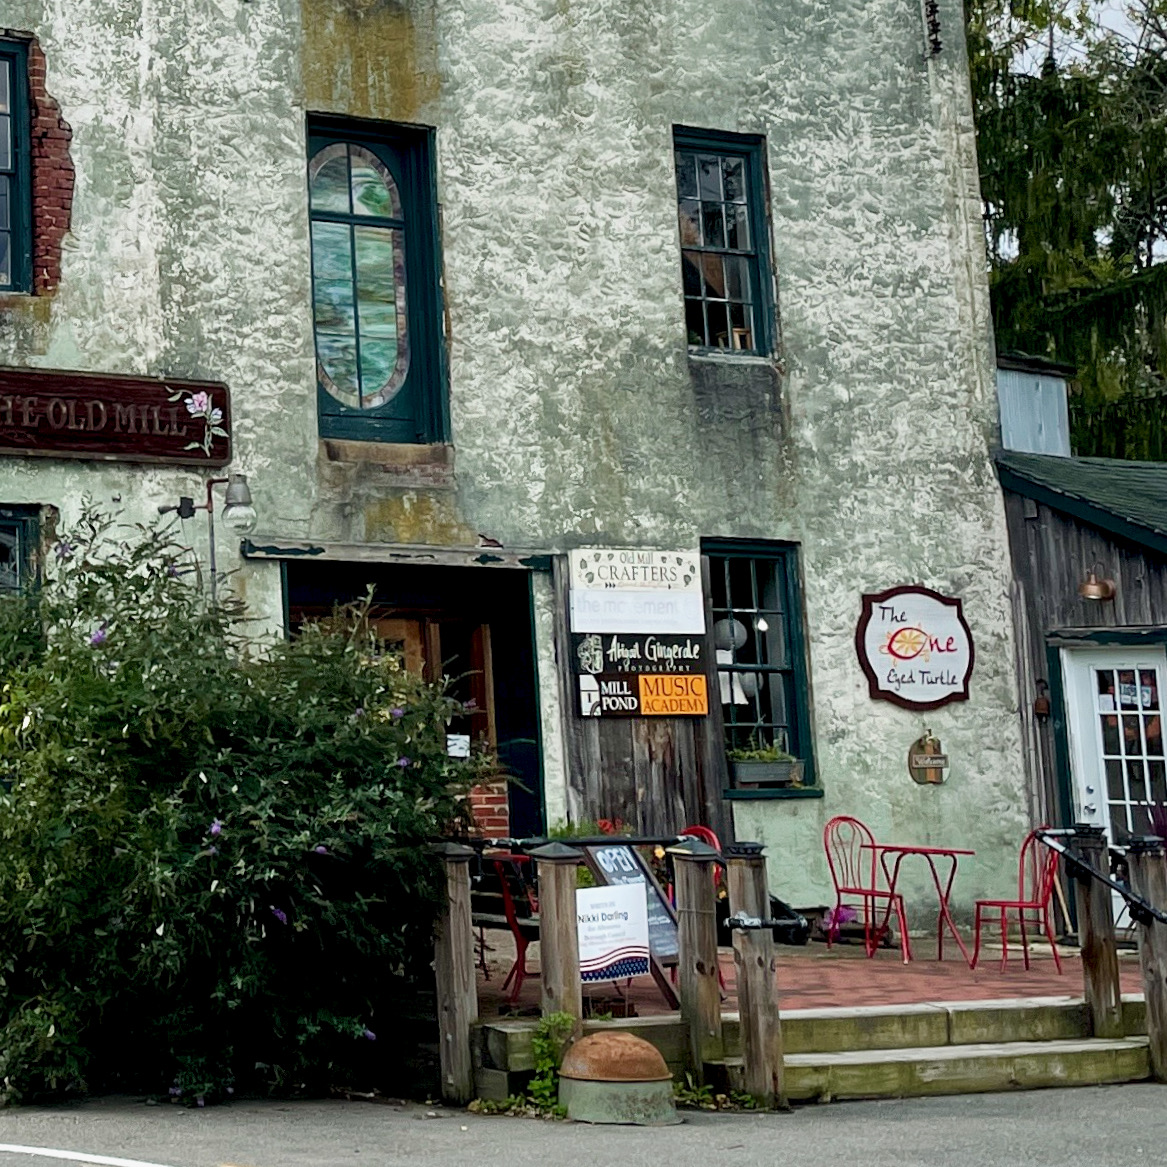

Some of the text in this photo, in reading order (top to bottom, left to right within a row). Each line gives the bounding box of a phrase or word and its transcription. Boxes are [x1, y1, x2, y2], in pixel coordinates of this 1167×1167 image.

[46, 398, 108, 431] OLD
[113, 402, 188, 437] MILL
[597, 564, 678, 582] CRAFTERS
[879, 606, 907, 623] The
[887, 626, 958, 660] One
[600, 681, 632, 696] MILL
[643, 677, 703, 697] MUSIC
[886, 668, 958, 691] Eyed Turtle
[602, 696, 638, 711] POND
[643, 699, 705, 713] ACADEMY
[596, 846, 639, 873] OPEN
